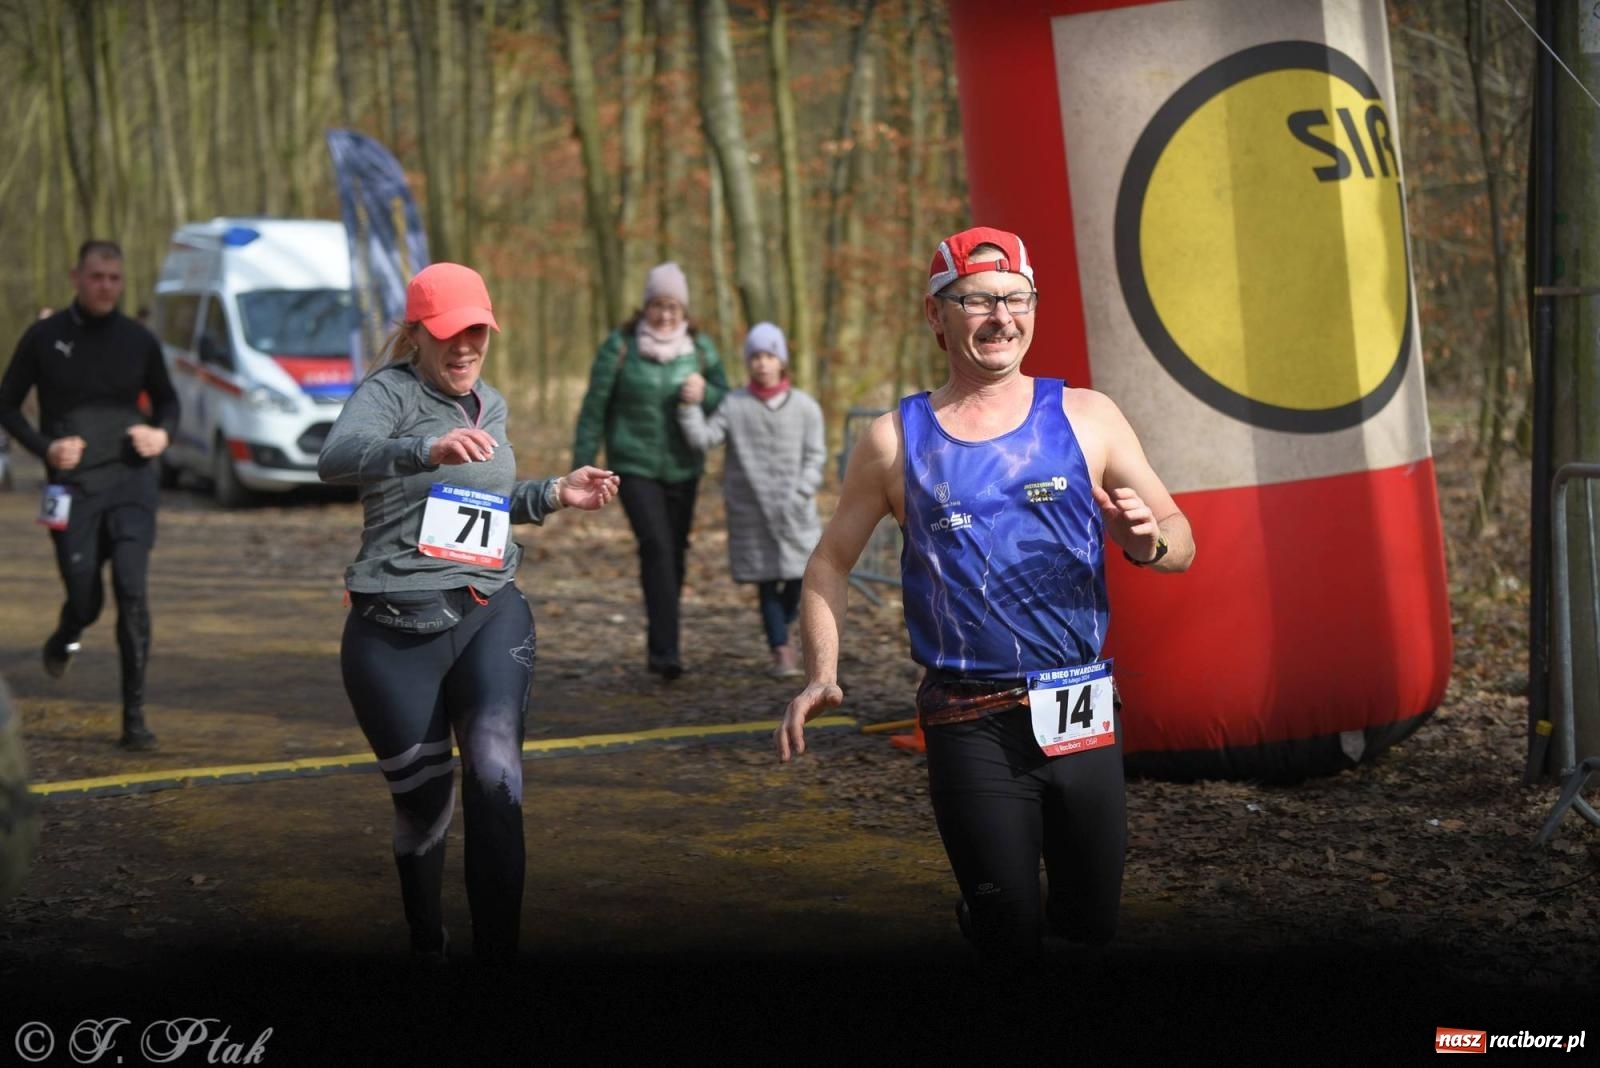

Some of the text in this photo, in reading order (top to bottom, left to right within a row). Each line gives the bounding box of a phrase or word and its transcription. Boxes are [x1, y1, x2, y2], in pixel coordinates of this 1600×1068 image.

[455, 505, 492, 548] 71
[1040, 663, 1105, 681] XII BIEG TWARDZIELA
[1056, 684, 1094, 734] 14
